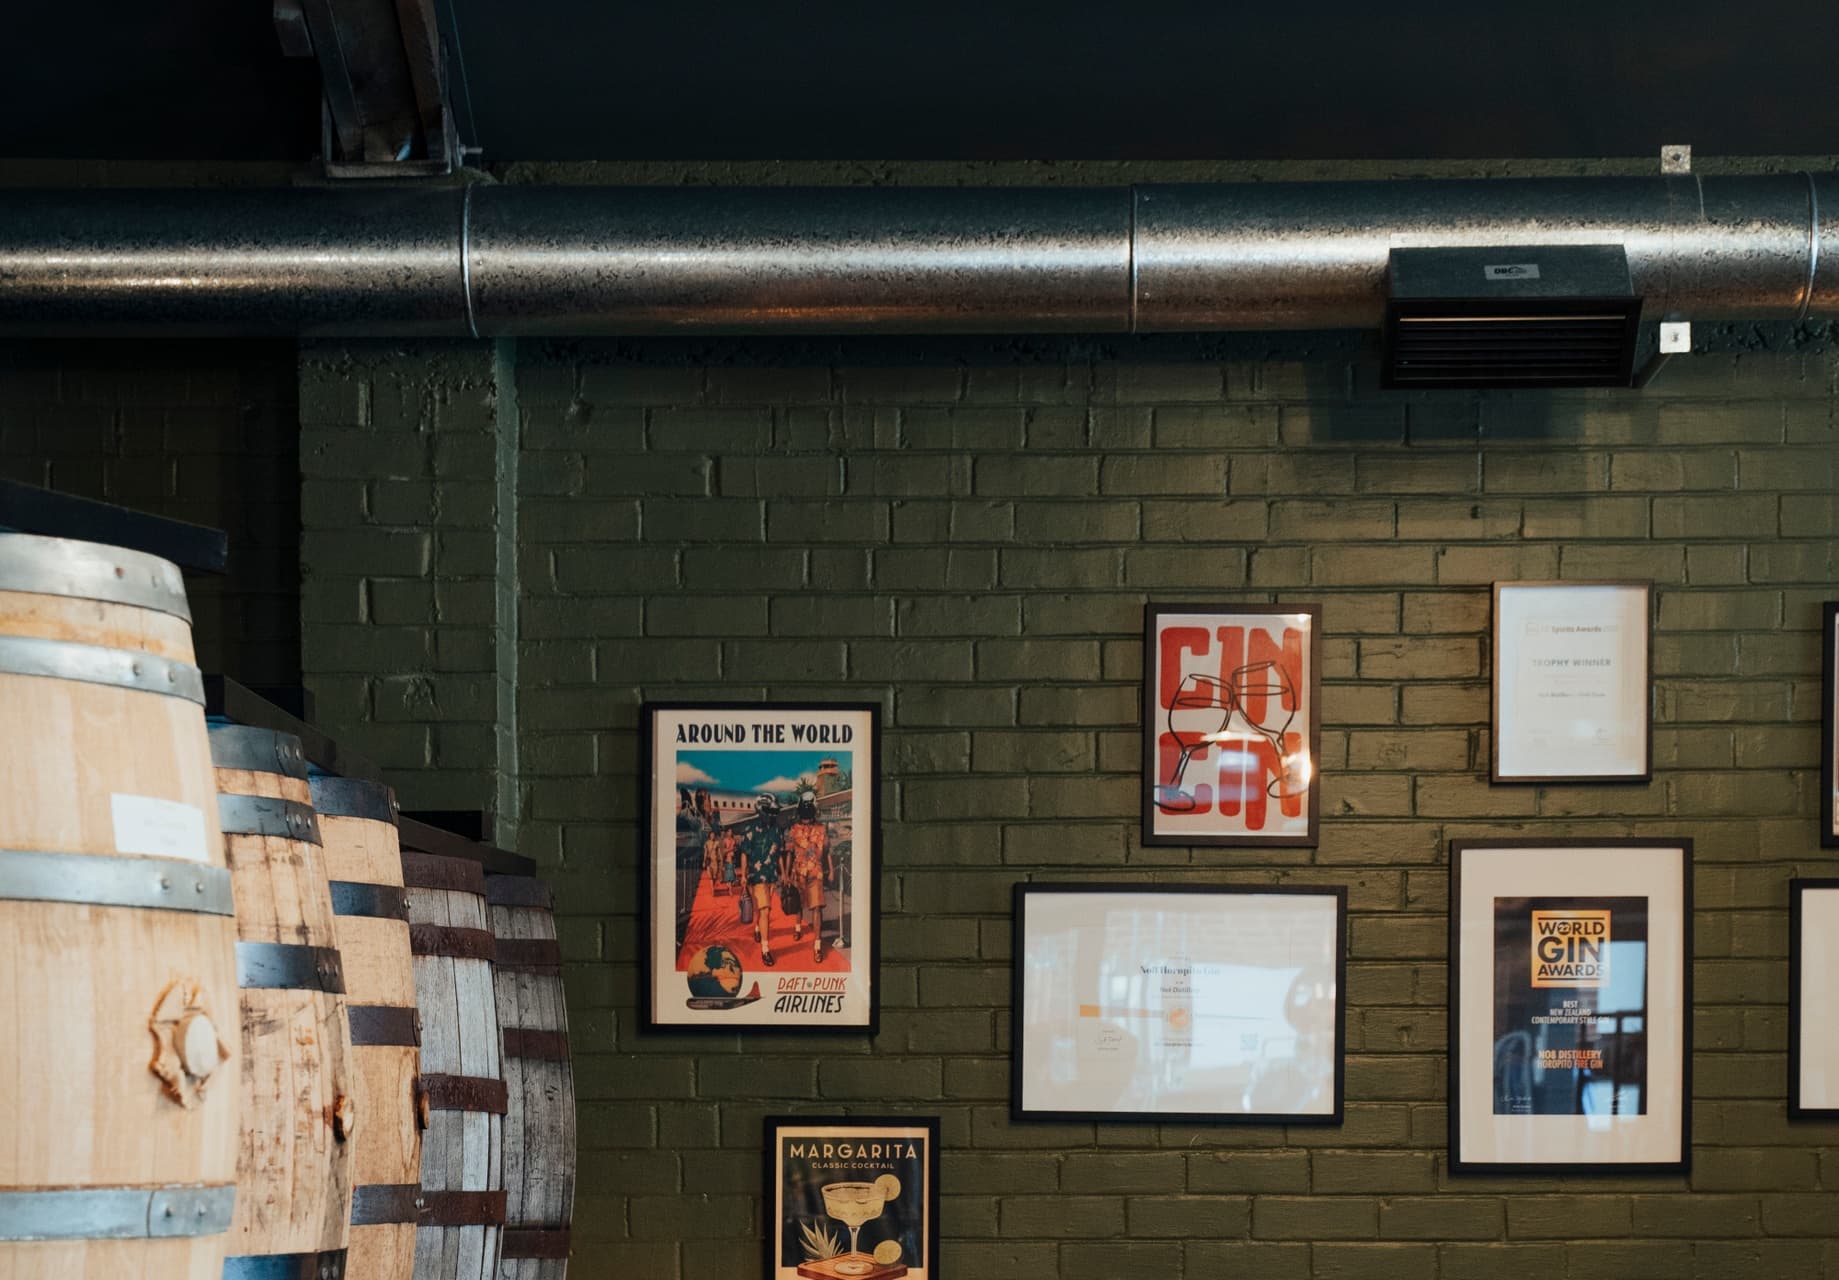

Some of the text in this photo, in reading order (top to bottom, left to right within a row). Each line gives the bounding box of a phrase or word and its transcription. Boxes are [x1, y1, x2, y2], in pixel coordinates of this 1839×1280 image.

[1159, 626, 1303, 725] CIN
[676, 723, 853, 743] AROUND THE WORLD
[1159, 731, 1302, 830] CIN
[1538, 921, 1605, 935] WORLD
[1538, 936, 1605, 963] GIN
[1538, 964, 1604, 976] AWARDS
[777, 977, 847, 990] DAFT PUNK
[774, 995, 845, 1013] AIRLINES
[1563, 1000, 1578, 1008] BEST
[1564, 1008, 1592, 1016] ZEALAND
[1531, 1016, 1577, 1024] CONTEMPORARY
[1558, 1050, 1602, 1059] DISTILLERY
[790, 1144, 917, 1159] MARGARITA
